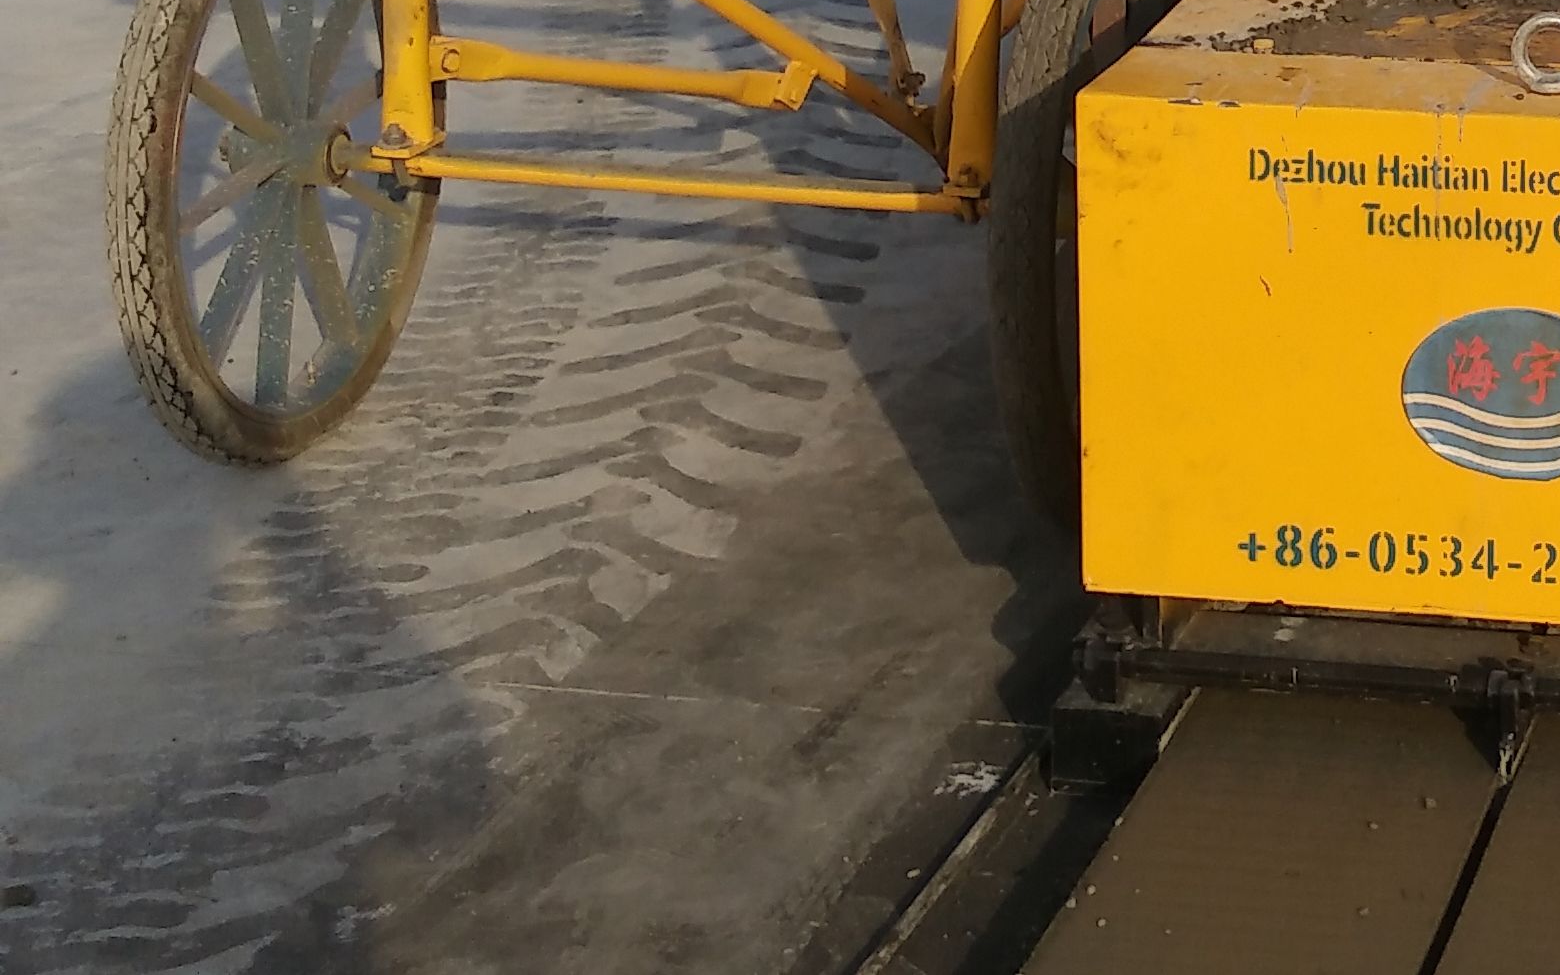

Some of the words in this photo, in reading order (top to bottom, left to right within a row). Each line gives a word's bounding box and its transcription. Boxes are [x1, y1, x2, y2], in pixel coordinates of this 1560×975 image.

[1249, 148, 1366, 186] Dezhou
[1377, 153, 1489, 192] Haitian
[1360, 202, 1543, 254] Technology
